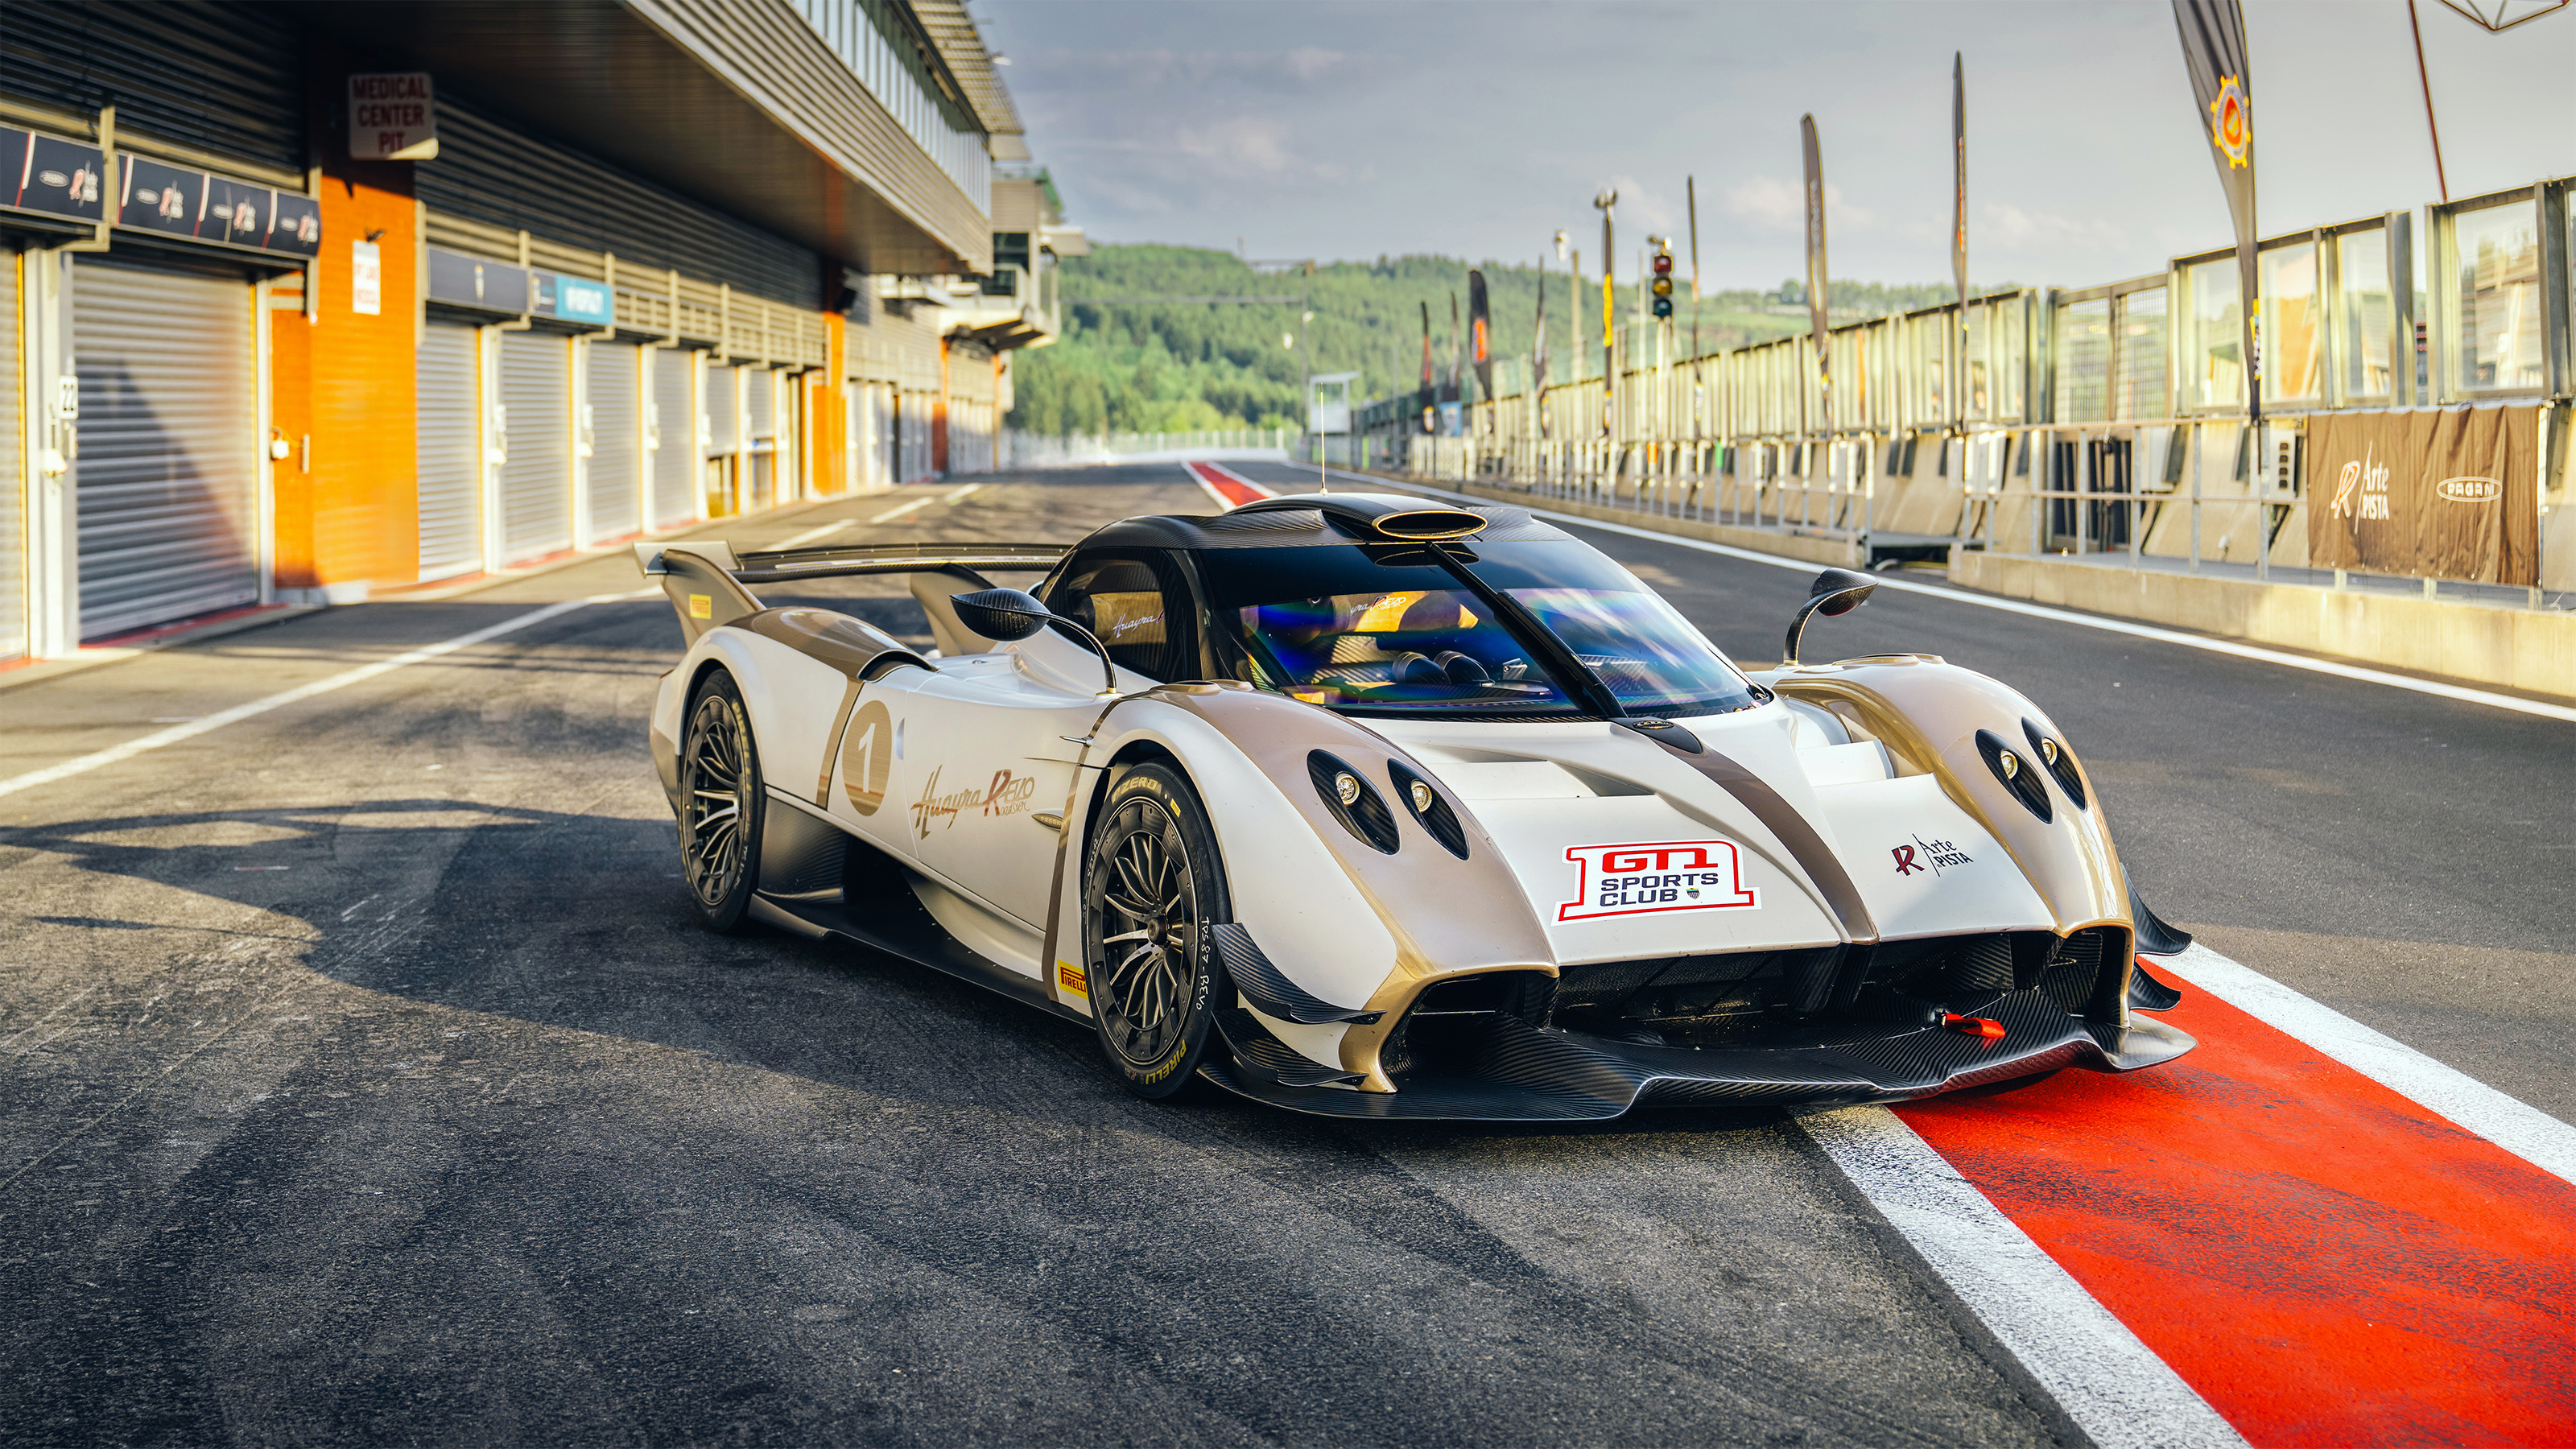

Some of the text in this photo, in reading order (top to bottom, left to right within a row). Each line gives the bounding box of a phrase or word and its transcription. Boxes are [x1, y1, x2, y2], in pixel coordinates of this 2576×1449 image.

[353, 76, 428, 100] MEDICAL
[357, 104, 425, 128] CENTER
[378, 130, 406, 155] PIT
[63, 382, 76, 412] 22
[2447, 481, 2495, 497] PAGANI
[2362, 493, 2390, 520] PISTA
[1113, 613, 1157, 638] Huayra
[858, 722, 876, 794] 1
[910, 764, 985, 840] Huayra
[1040, 816, 1062, 827] PAGAN
[1602, 848, 1719, 873] GT1
[1933, 852, 1974, 868] PISTA
[1600, 873, 1719, 891] SPORTS
[1600, 888, 1678, 907] CLUB
[1060, 966, 1087, 993] PIRELLI
[1145, 1038, 1187, 1085] PIRELLI
